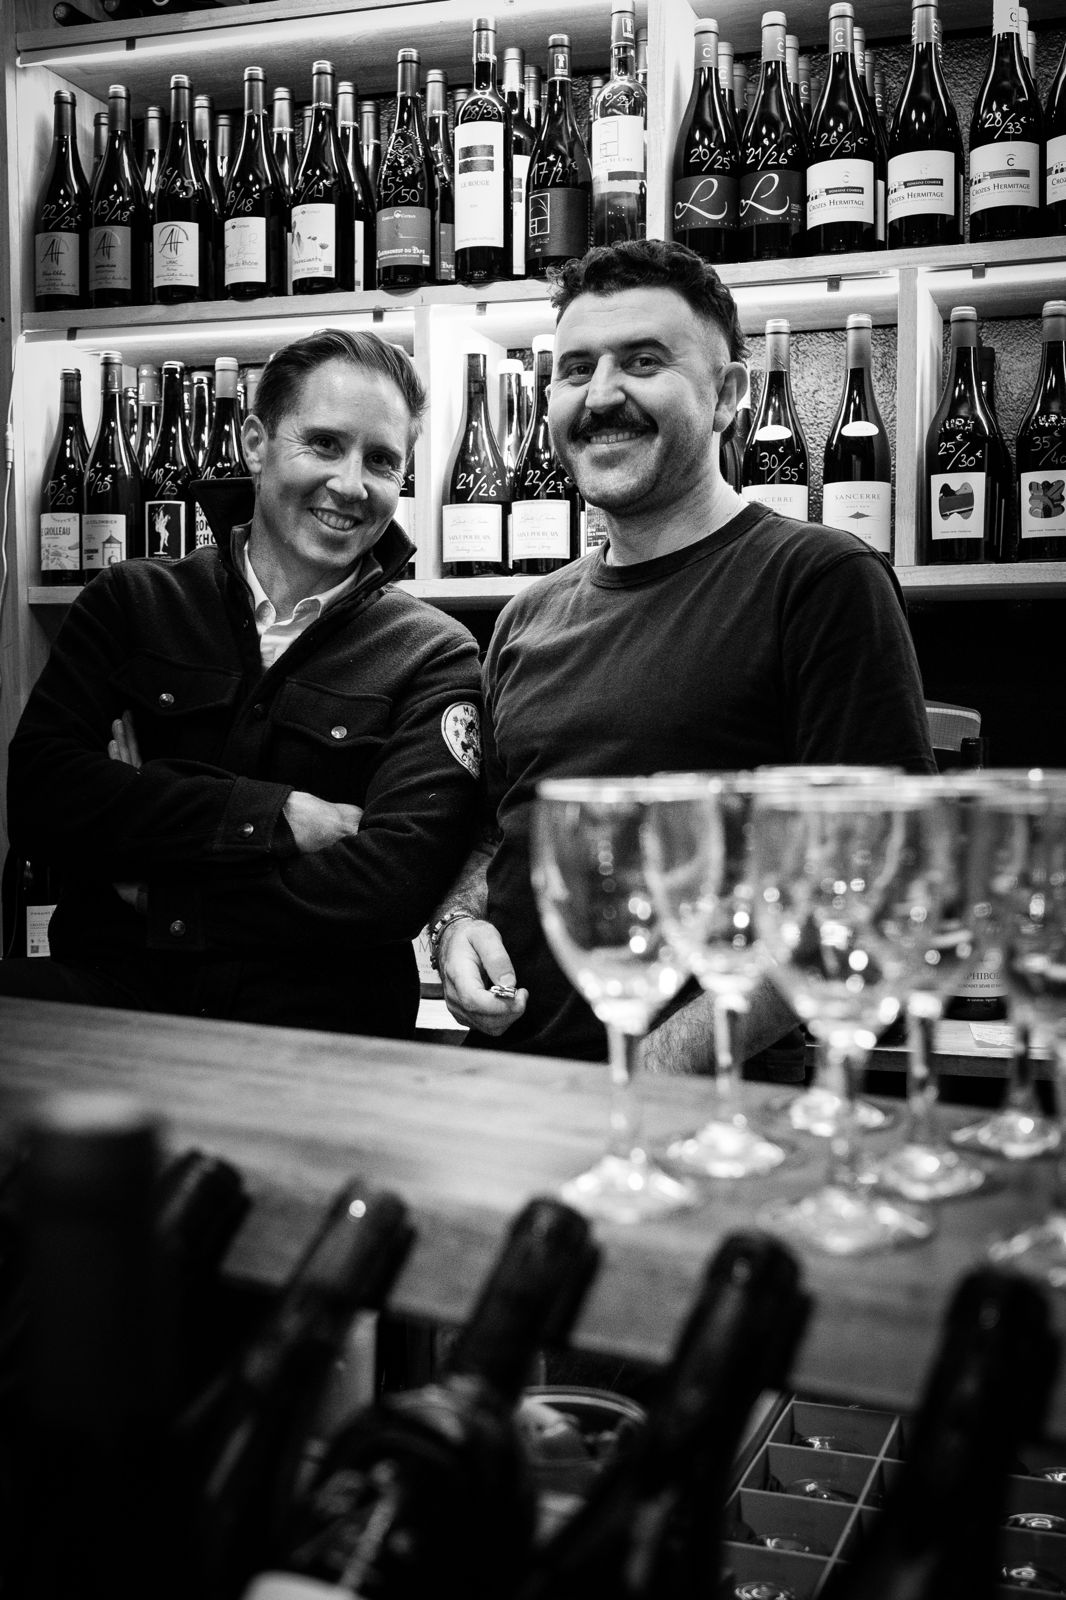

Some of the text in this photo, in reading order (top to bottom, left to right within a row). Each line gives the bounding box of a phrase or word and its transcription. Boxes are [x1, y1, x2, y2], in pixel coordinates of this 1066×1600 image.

[993, 182, 1031, 191] HERMITAGE
[907, 190, 944, 200] HERMITAGE
[829, 198, 865, 207] HERMITAGE
